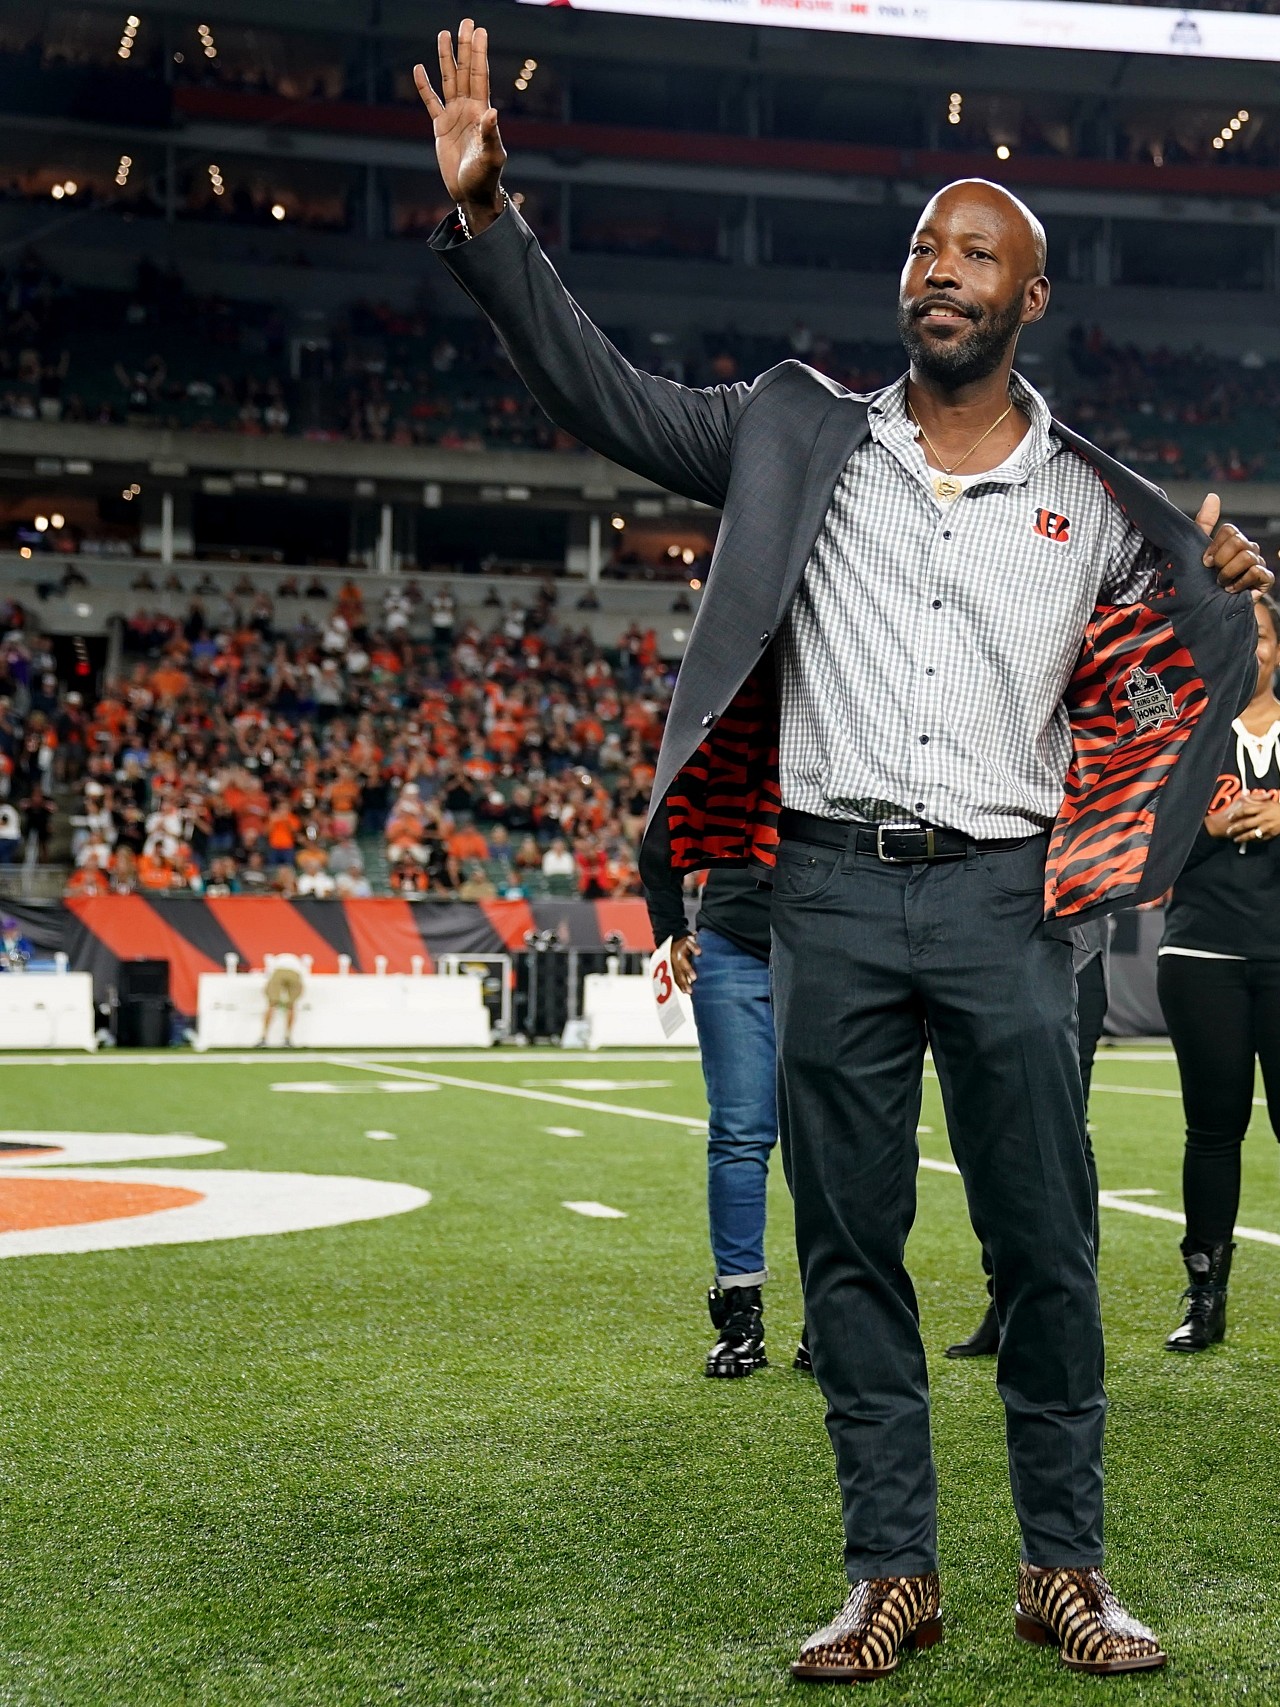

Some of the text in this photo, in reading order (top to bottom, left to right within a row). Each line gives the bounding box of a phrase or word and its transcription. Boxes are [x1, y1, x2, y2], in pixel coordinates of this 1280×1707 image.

[1136, 694, 1159, 707] RING OF
[1137, 704, 1168, 720] HONOR
